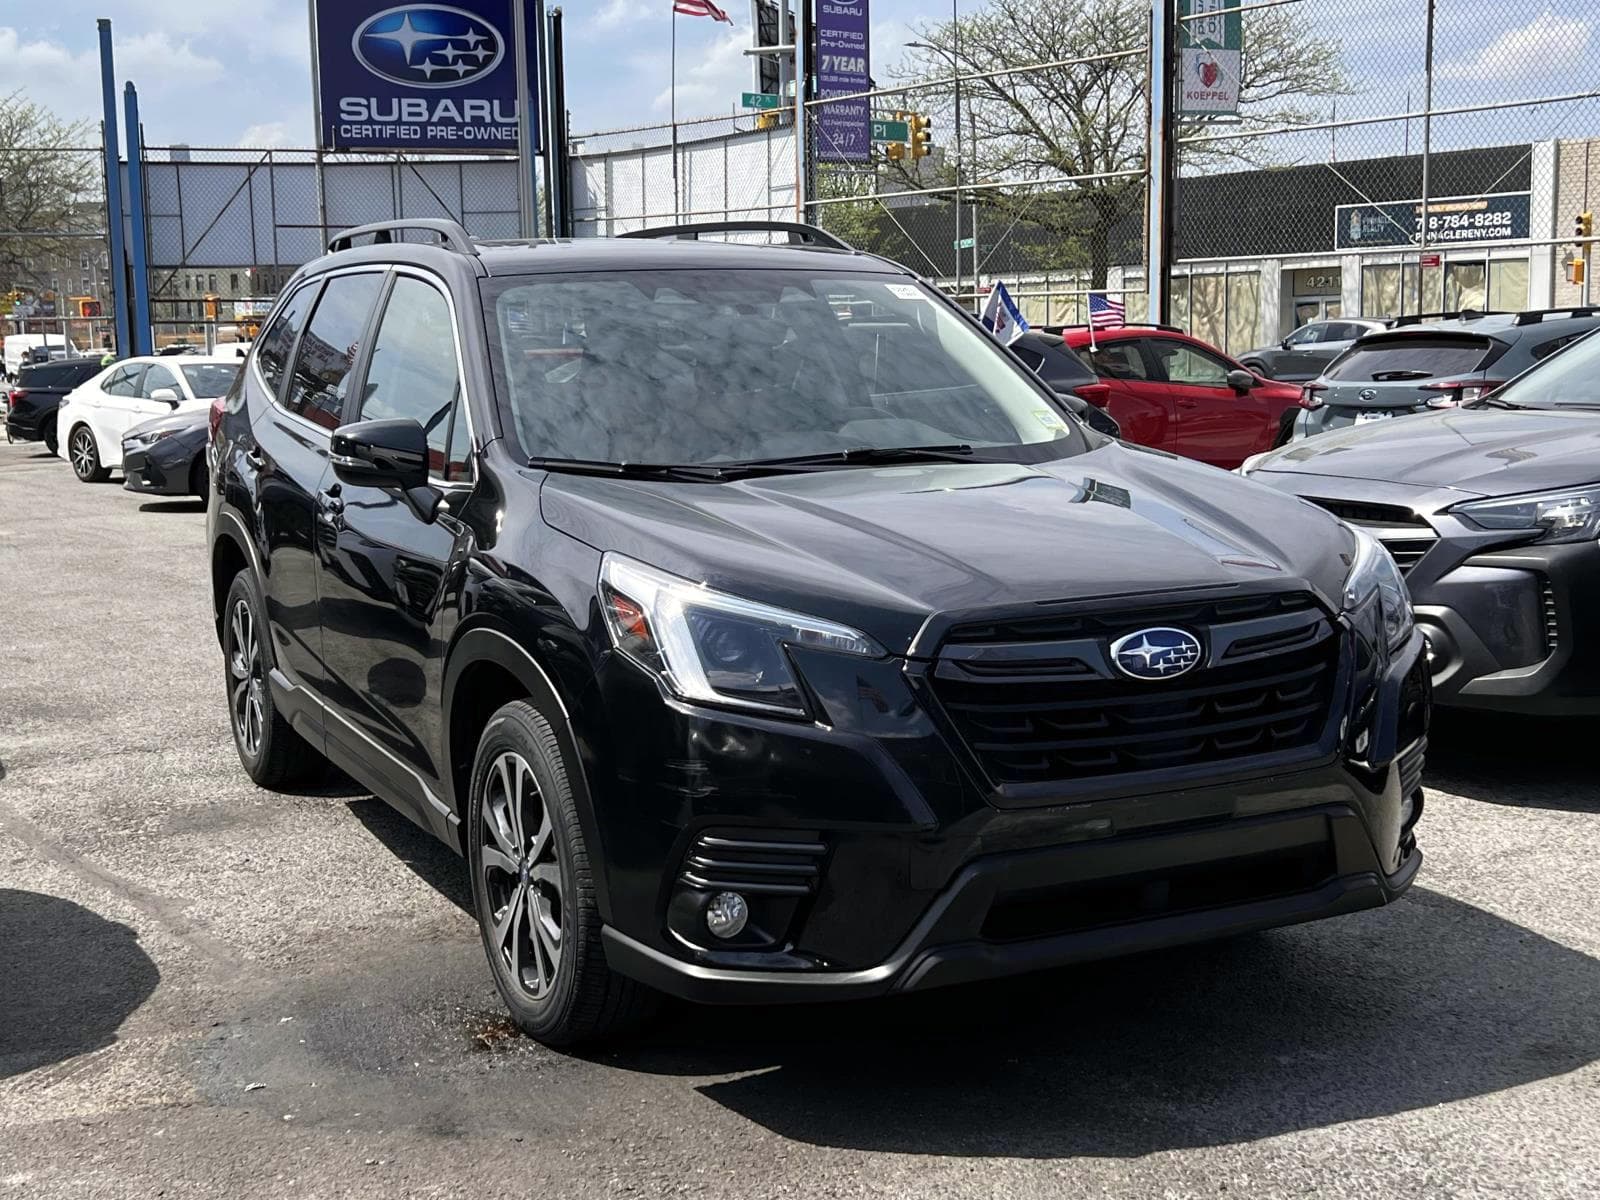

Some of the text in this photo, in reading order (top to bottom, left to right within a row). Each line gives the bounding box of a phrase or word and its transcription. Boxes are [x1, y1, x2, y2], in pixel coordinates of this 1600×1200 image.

[822, 4, 863, 16] SUBARU
[820, 29, 864, 40] CERTIFIED
[820, 39, 866, 50] Pre-Owned
[821, 55, 866, 73] 7 YEAR
[749, 95, 762, 107] 42
[1186, 91, 1229, 101] KOEPPEL
[339, 97, 520, 124] SUBARU
[823, 103, 865, 116] WARRANTY
[340, 125, 520, 140] CERTIFIED PRE-OWNED
[832, 132, 856, 147] 24/7
[1415, 211, 1511, 230] 78-784-8282
[1415, 227, 1511, 241] PNNACLERENY.COM
